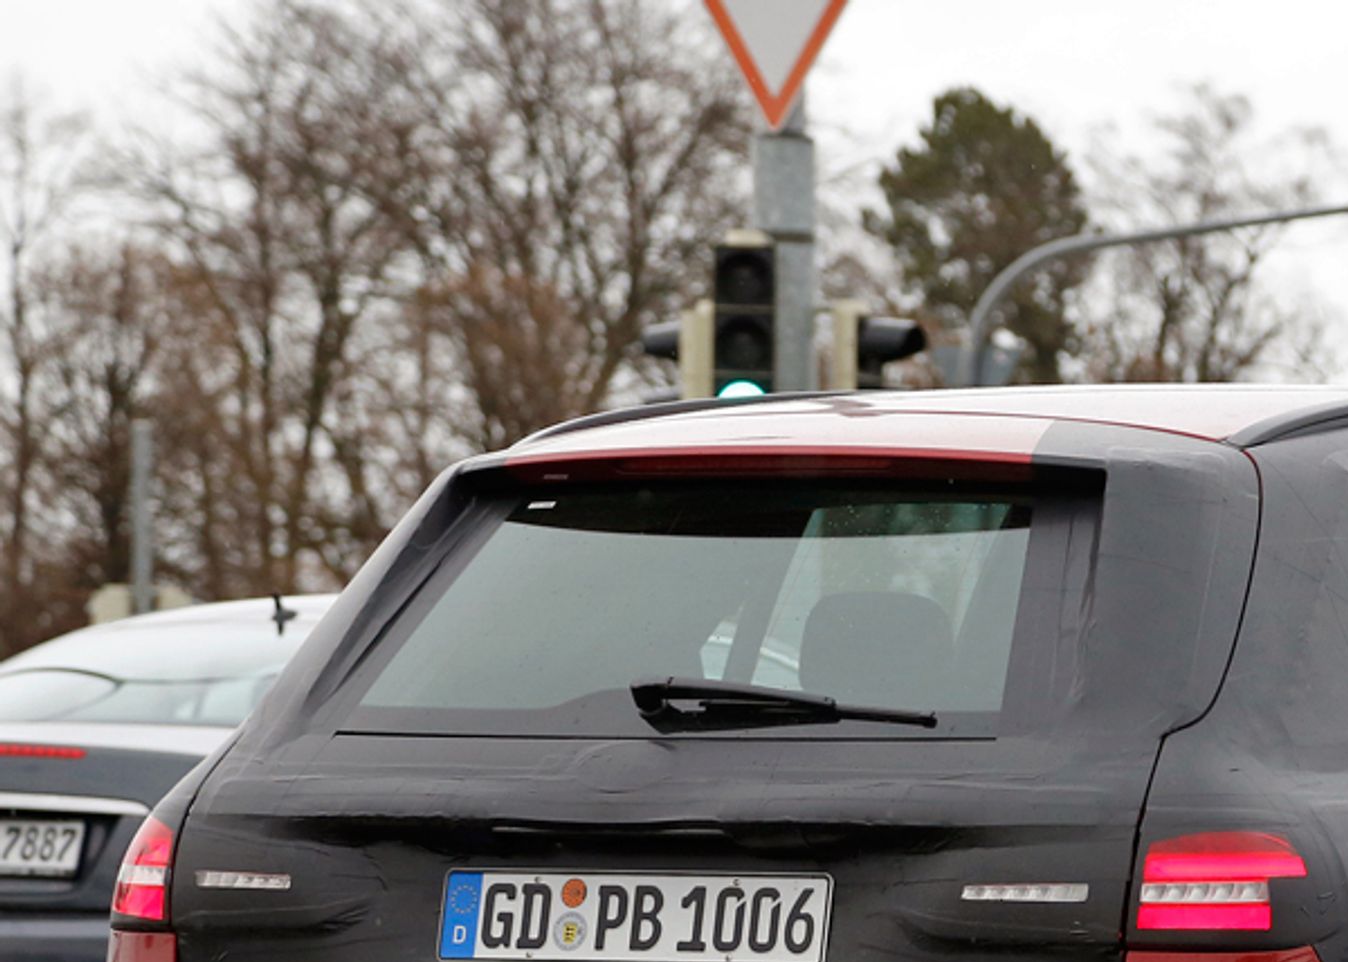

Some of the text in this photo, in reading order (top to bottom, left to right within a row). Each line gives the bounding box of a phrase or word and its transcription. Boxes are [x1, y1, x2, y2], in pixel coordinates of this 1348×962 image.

[2, 825, 77, 862] 7887
[452, 925, 467, 944] D
[480, 883, 815, 954] GD PB 1006
